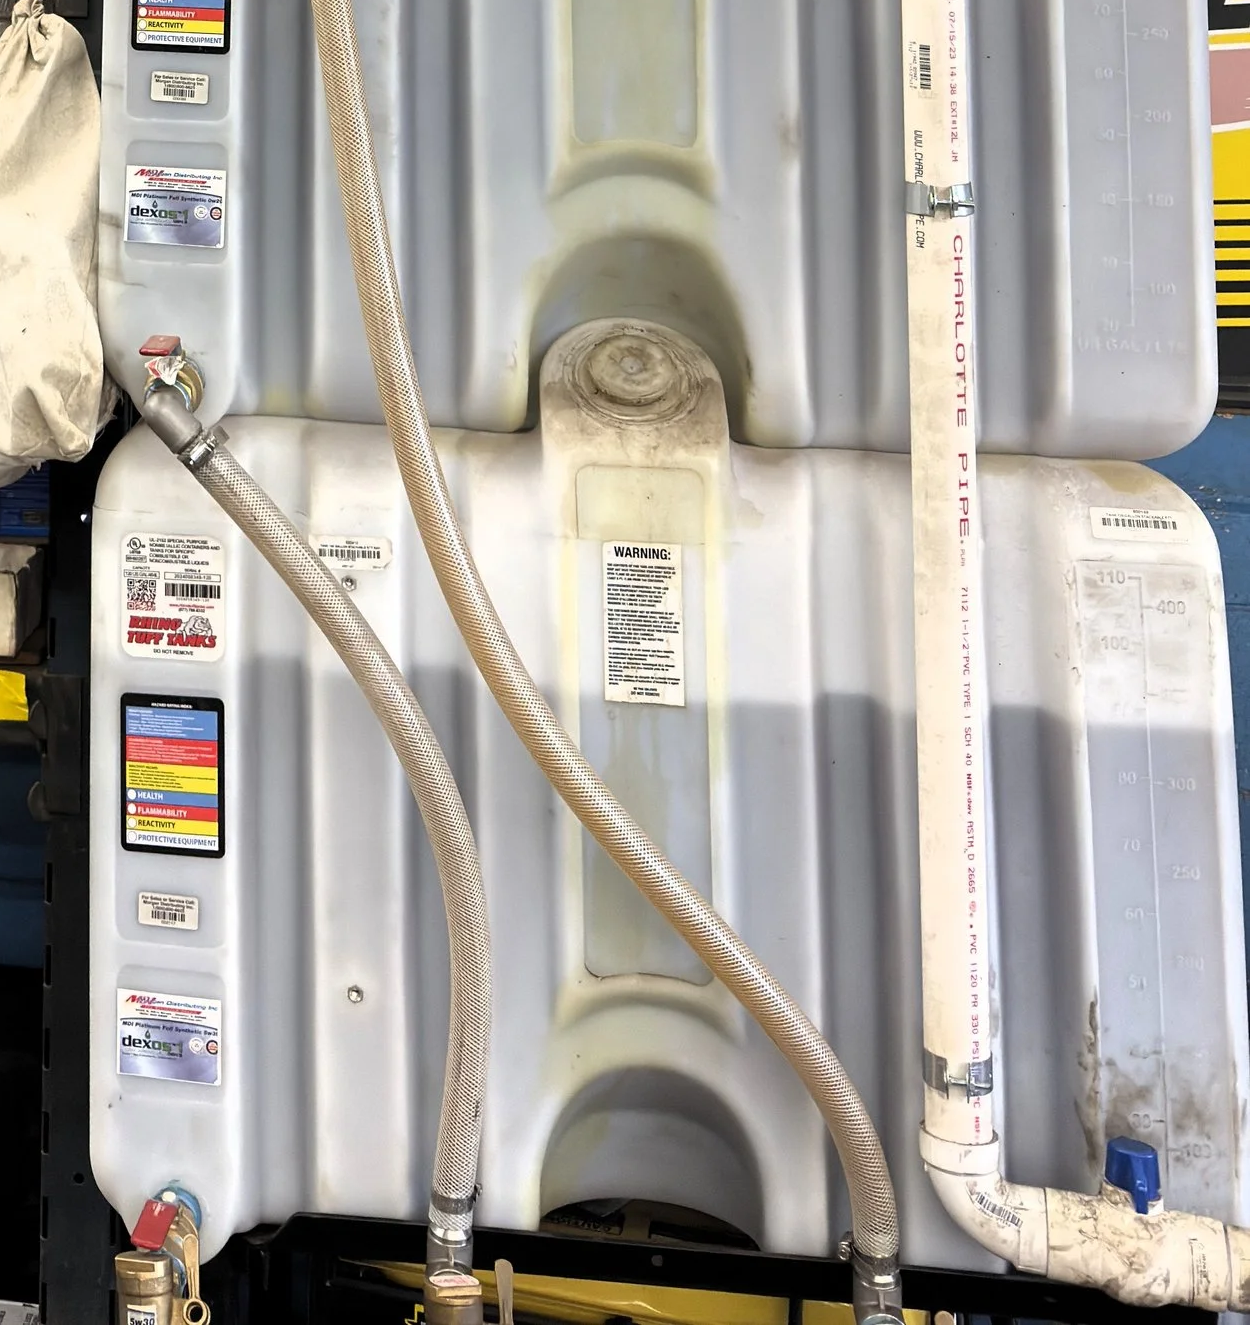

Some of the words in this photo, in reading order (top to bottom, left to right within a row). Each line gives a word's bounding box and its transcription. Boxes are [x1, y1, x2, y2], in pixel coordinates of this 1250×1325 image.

[148, 10, 196, 18] FLAMMABILITY
[148, 21, 184, 29] REACTIVITY
[147, 34, 185, 43] PROTECTIVE
[185, 35, 223, 44] EQUIPMENT
[953, 234, 967, 428] CHARLOTTE
[957, 453, 969, 538] PIPE
[614, 546, 671, 560] WARNING:
[1156, 600, 1186, 616] 400
[127, 631, 164, 645] TUFF
[167, 633, 217, 648] TANKS
[962, 682, 971, 707] TYPE
[964, 727, 972, 747] SCH
[137, 791, 163, 800] HEALTH
[137, 806, 187, 817] FLAMMABILITY
[137, 819, 175, 829] REACTIVITY
[138, 834, 177, 844] PROTECTIVE
[178, 836, 216, 847] EQUIPMENT
